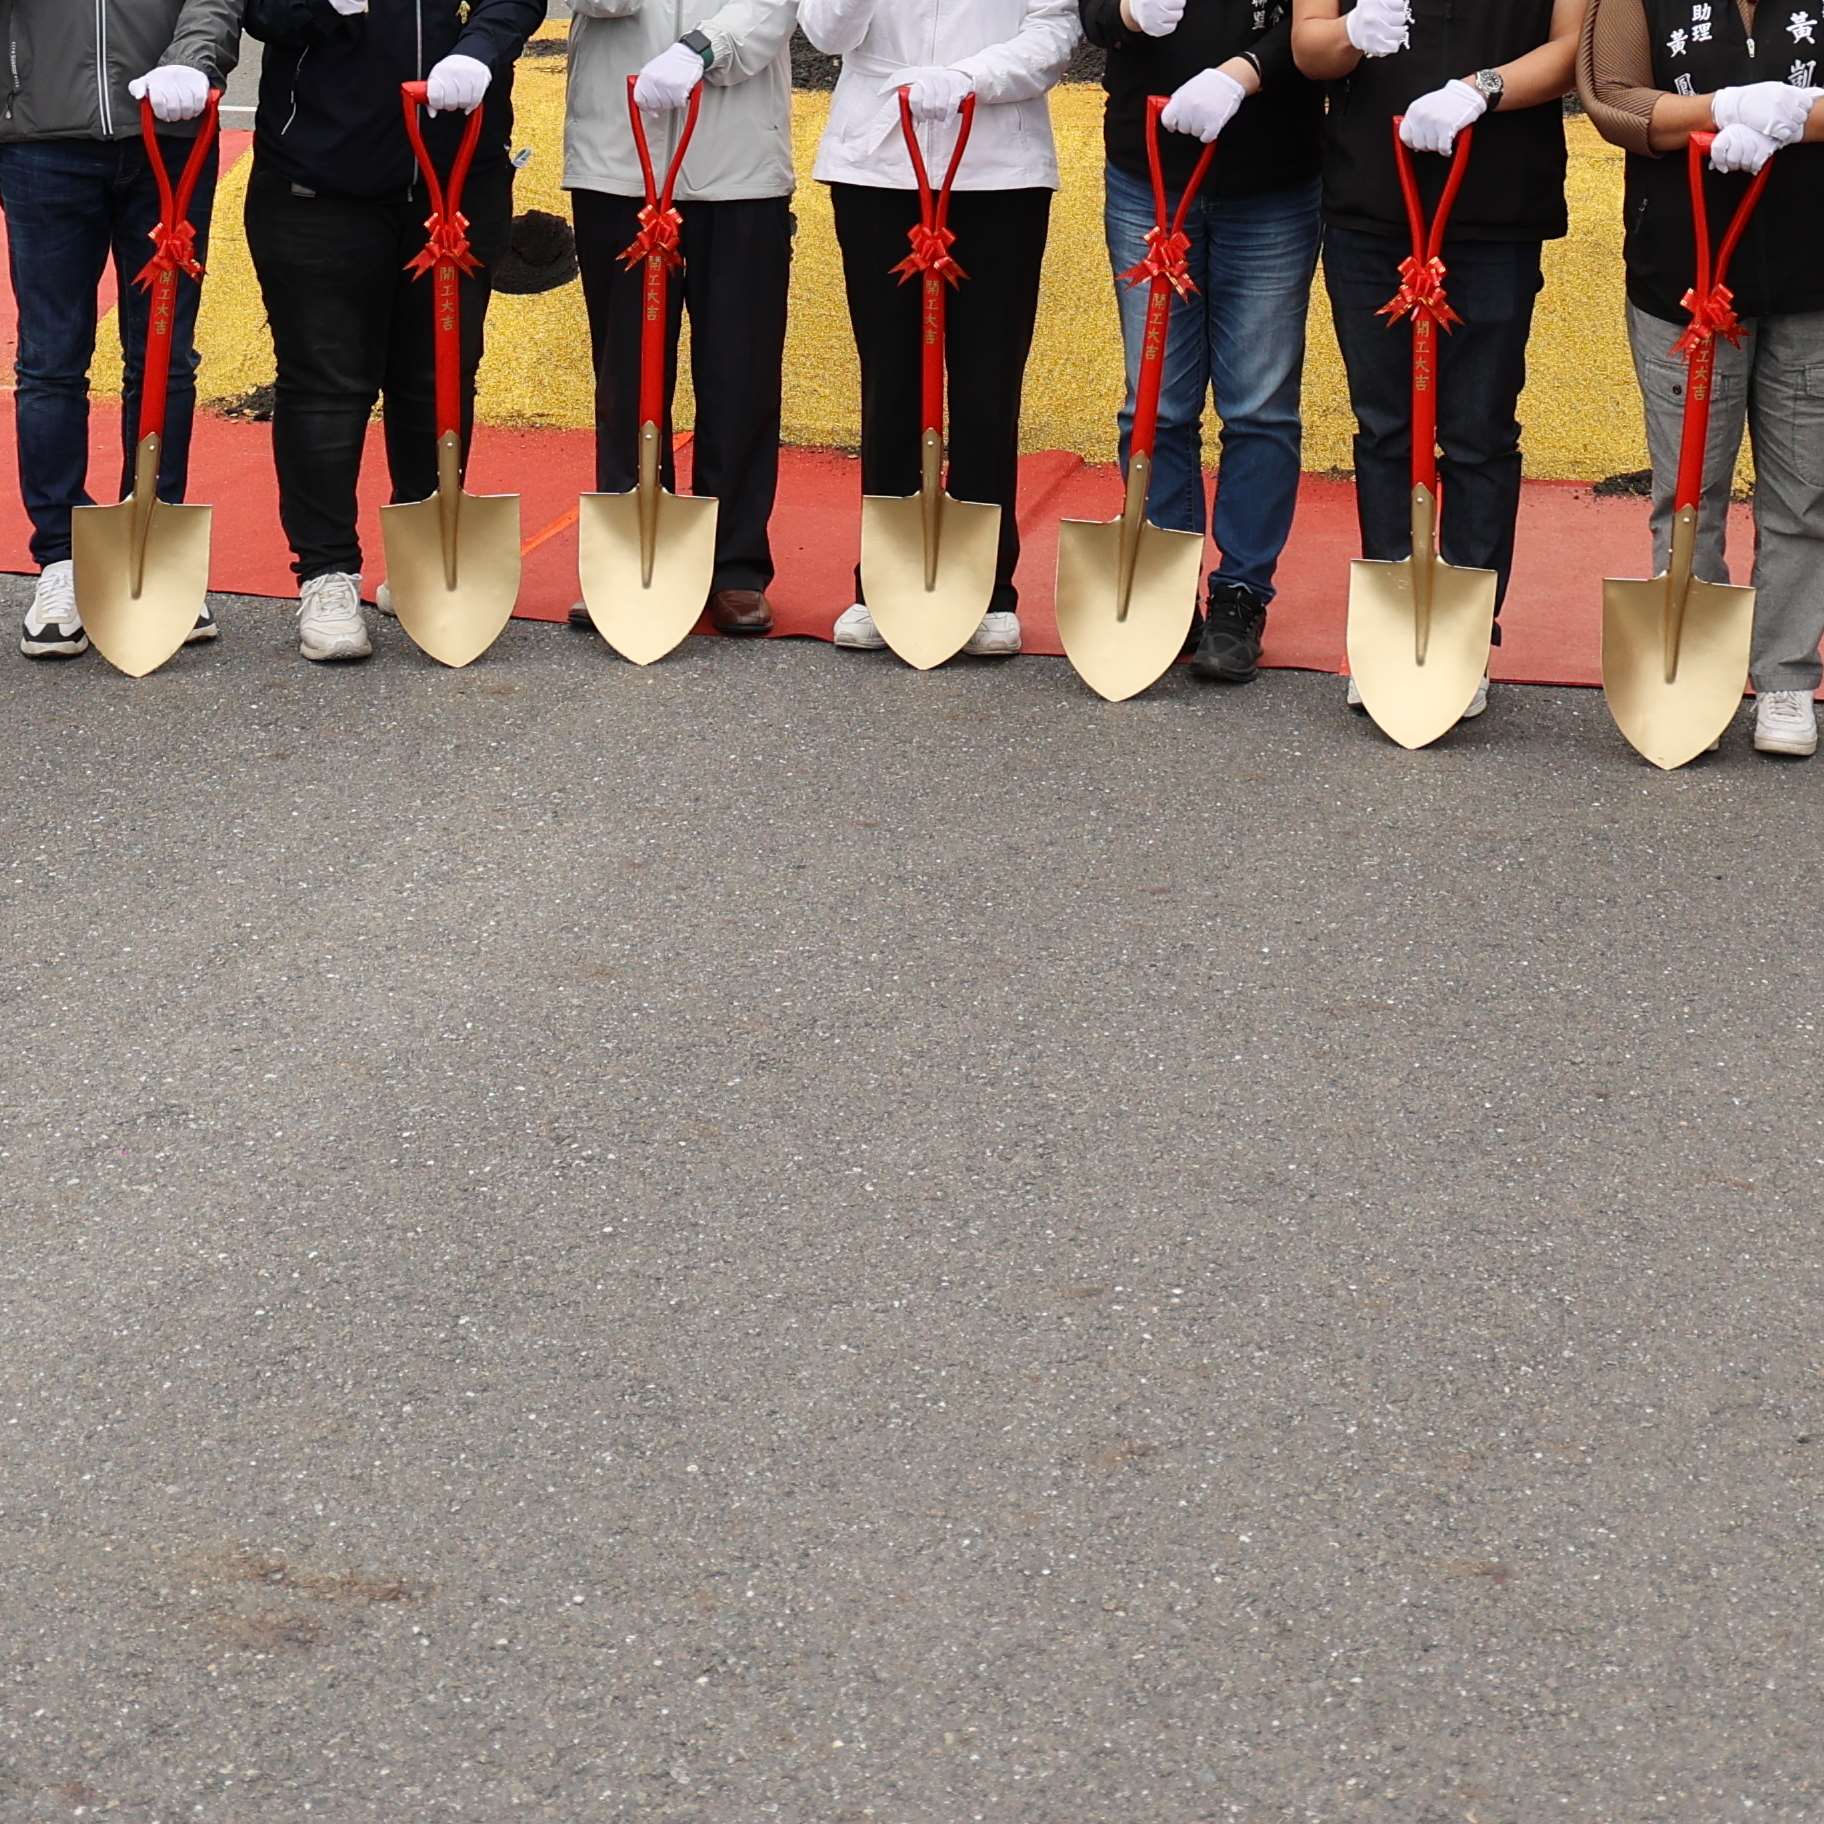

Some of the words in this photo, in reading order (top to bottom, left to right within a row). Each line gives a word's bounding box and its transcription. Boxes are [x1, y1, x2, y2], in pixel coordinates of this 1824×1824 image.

[1691, 2, 1713, 43] 助理
[1415, 319, 1430, 391] 開工大吉
